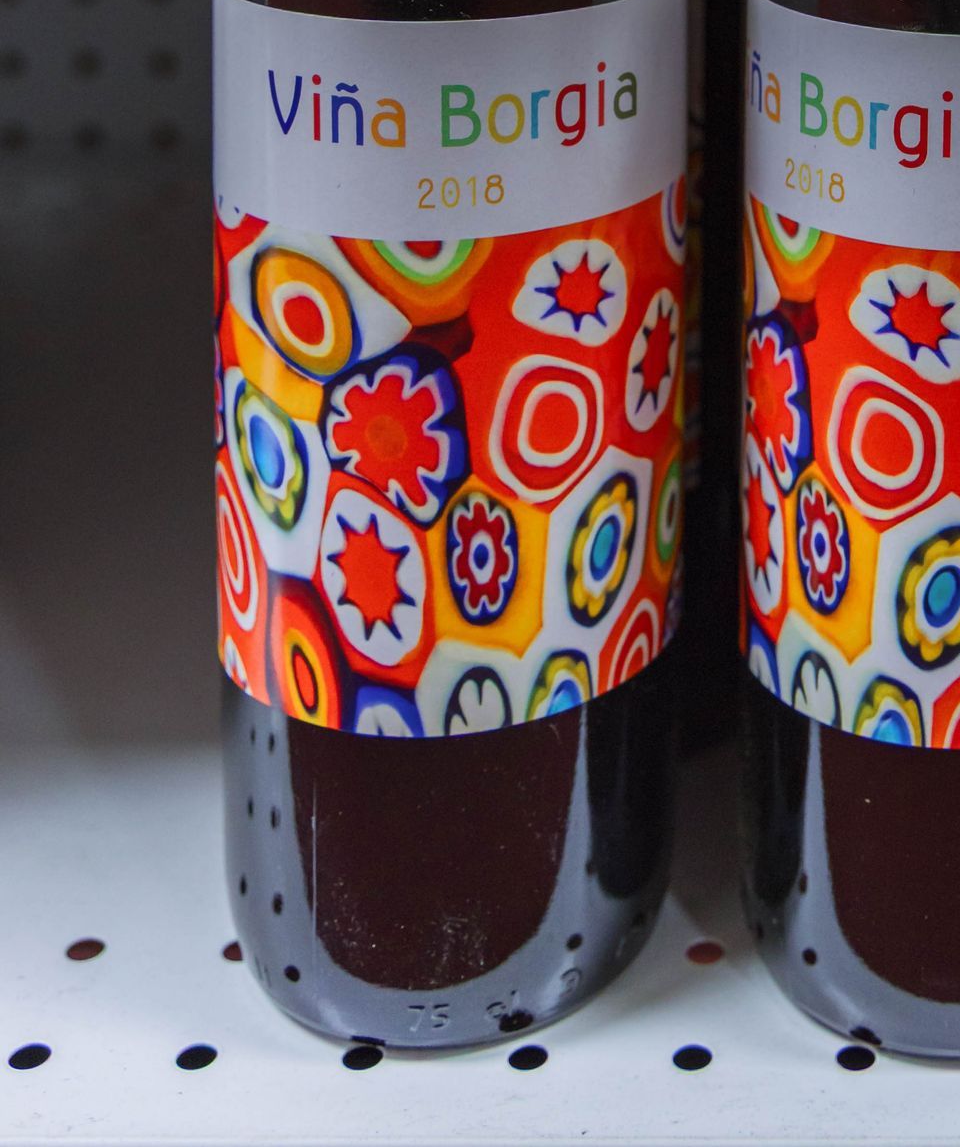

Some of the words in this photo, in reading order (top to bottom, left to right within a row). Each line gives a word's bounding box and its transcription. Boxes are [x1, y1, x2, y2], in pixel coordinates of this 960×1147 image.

[268, 69, 406, 147] Viña
[441, 61, 638, 147] Borgia
[417, 174, 505, 209] 2018
[785, 157, 845, 203] 2018
